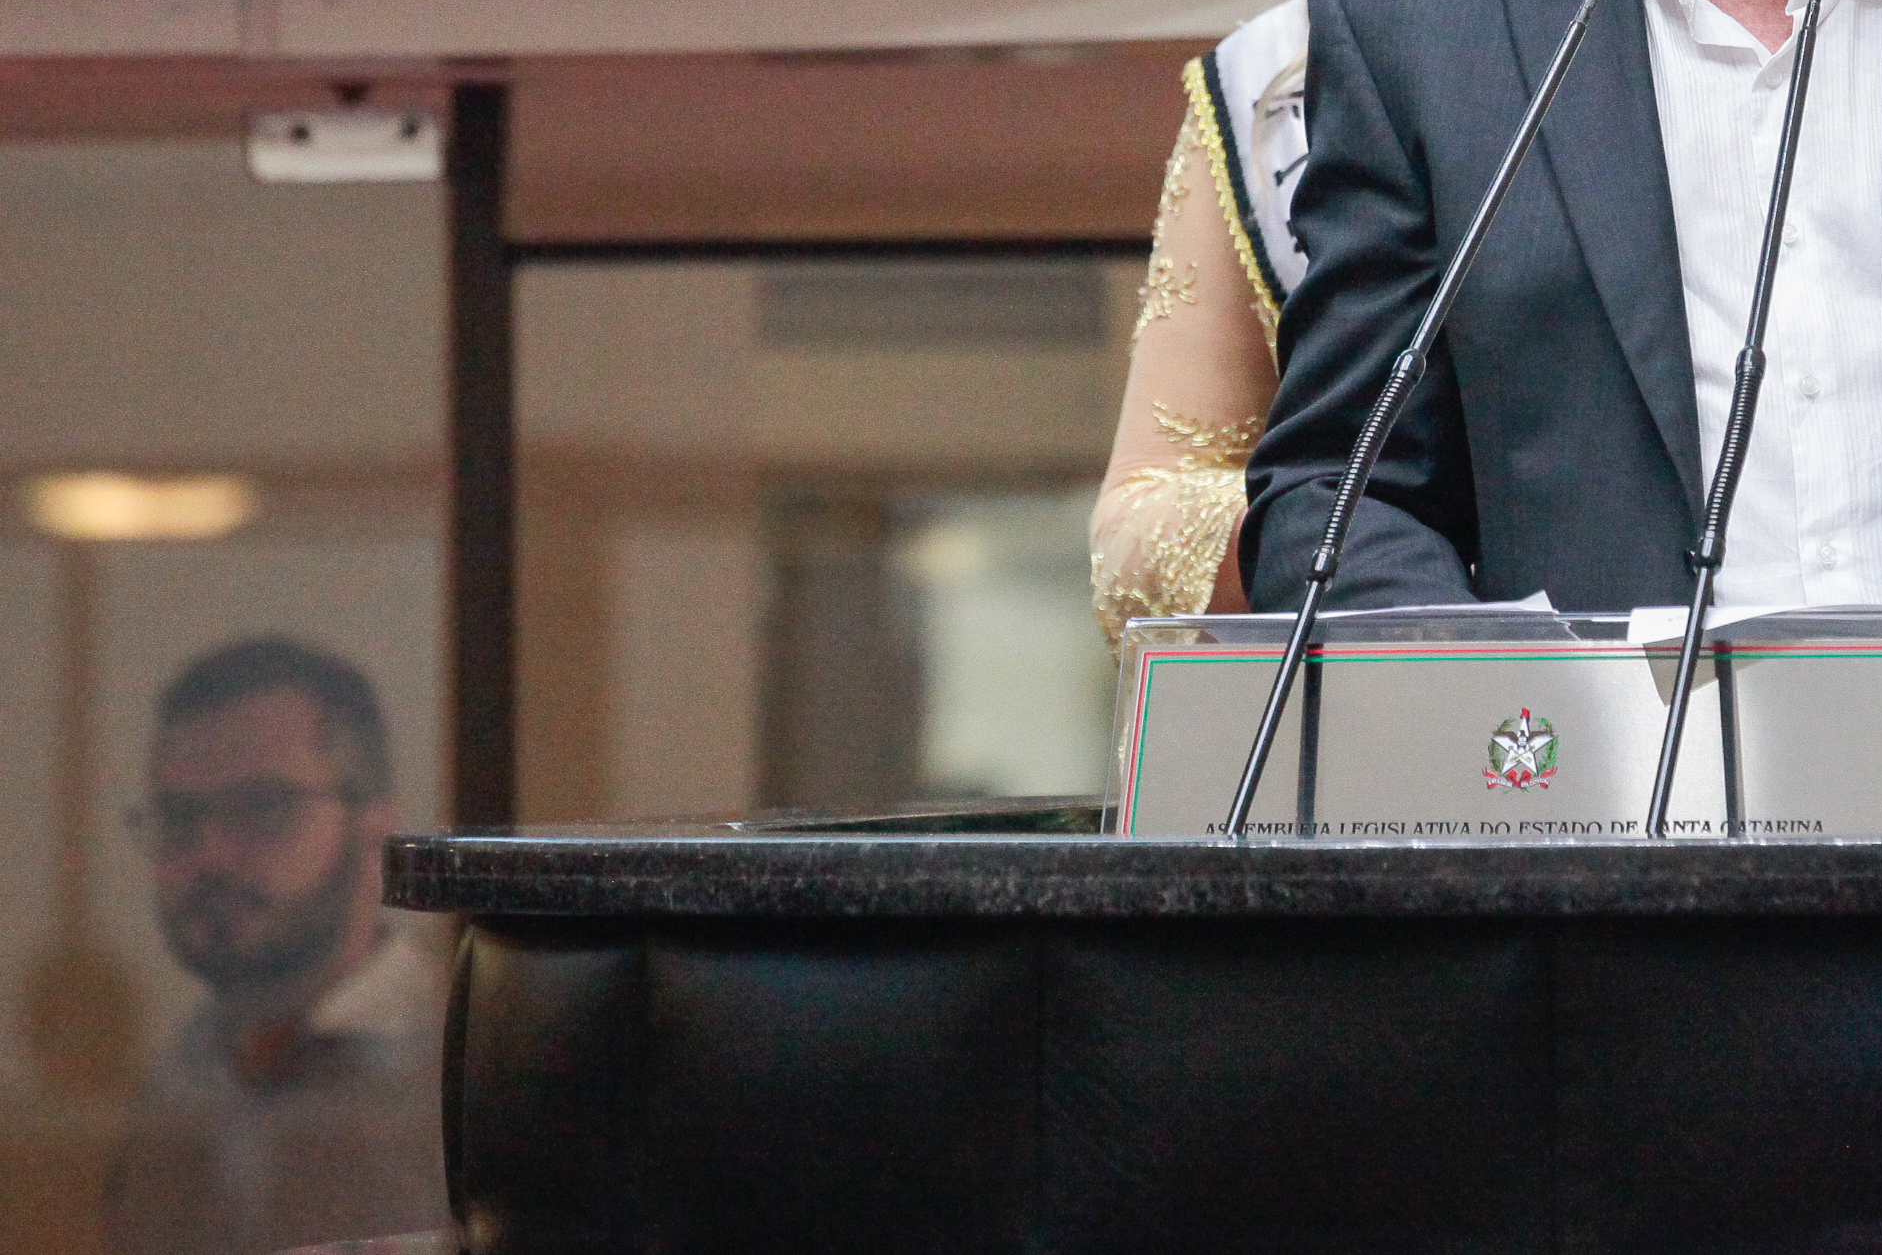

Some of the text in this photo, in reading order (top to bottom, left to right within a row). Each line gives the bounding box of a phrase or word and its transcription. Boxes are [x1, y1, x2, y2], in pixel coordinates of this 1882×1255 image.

[1204, 821, 1331, 836] ASEMBLEIA
[1479, 821, 1512, 835] DO
[1518, 821, 1603, 835] ESTADO
[1645, 820, 1712, 835] ANTA
